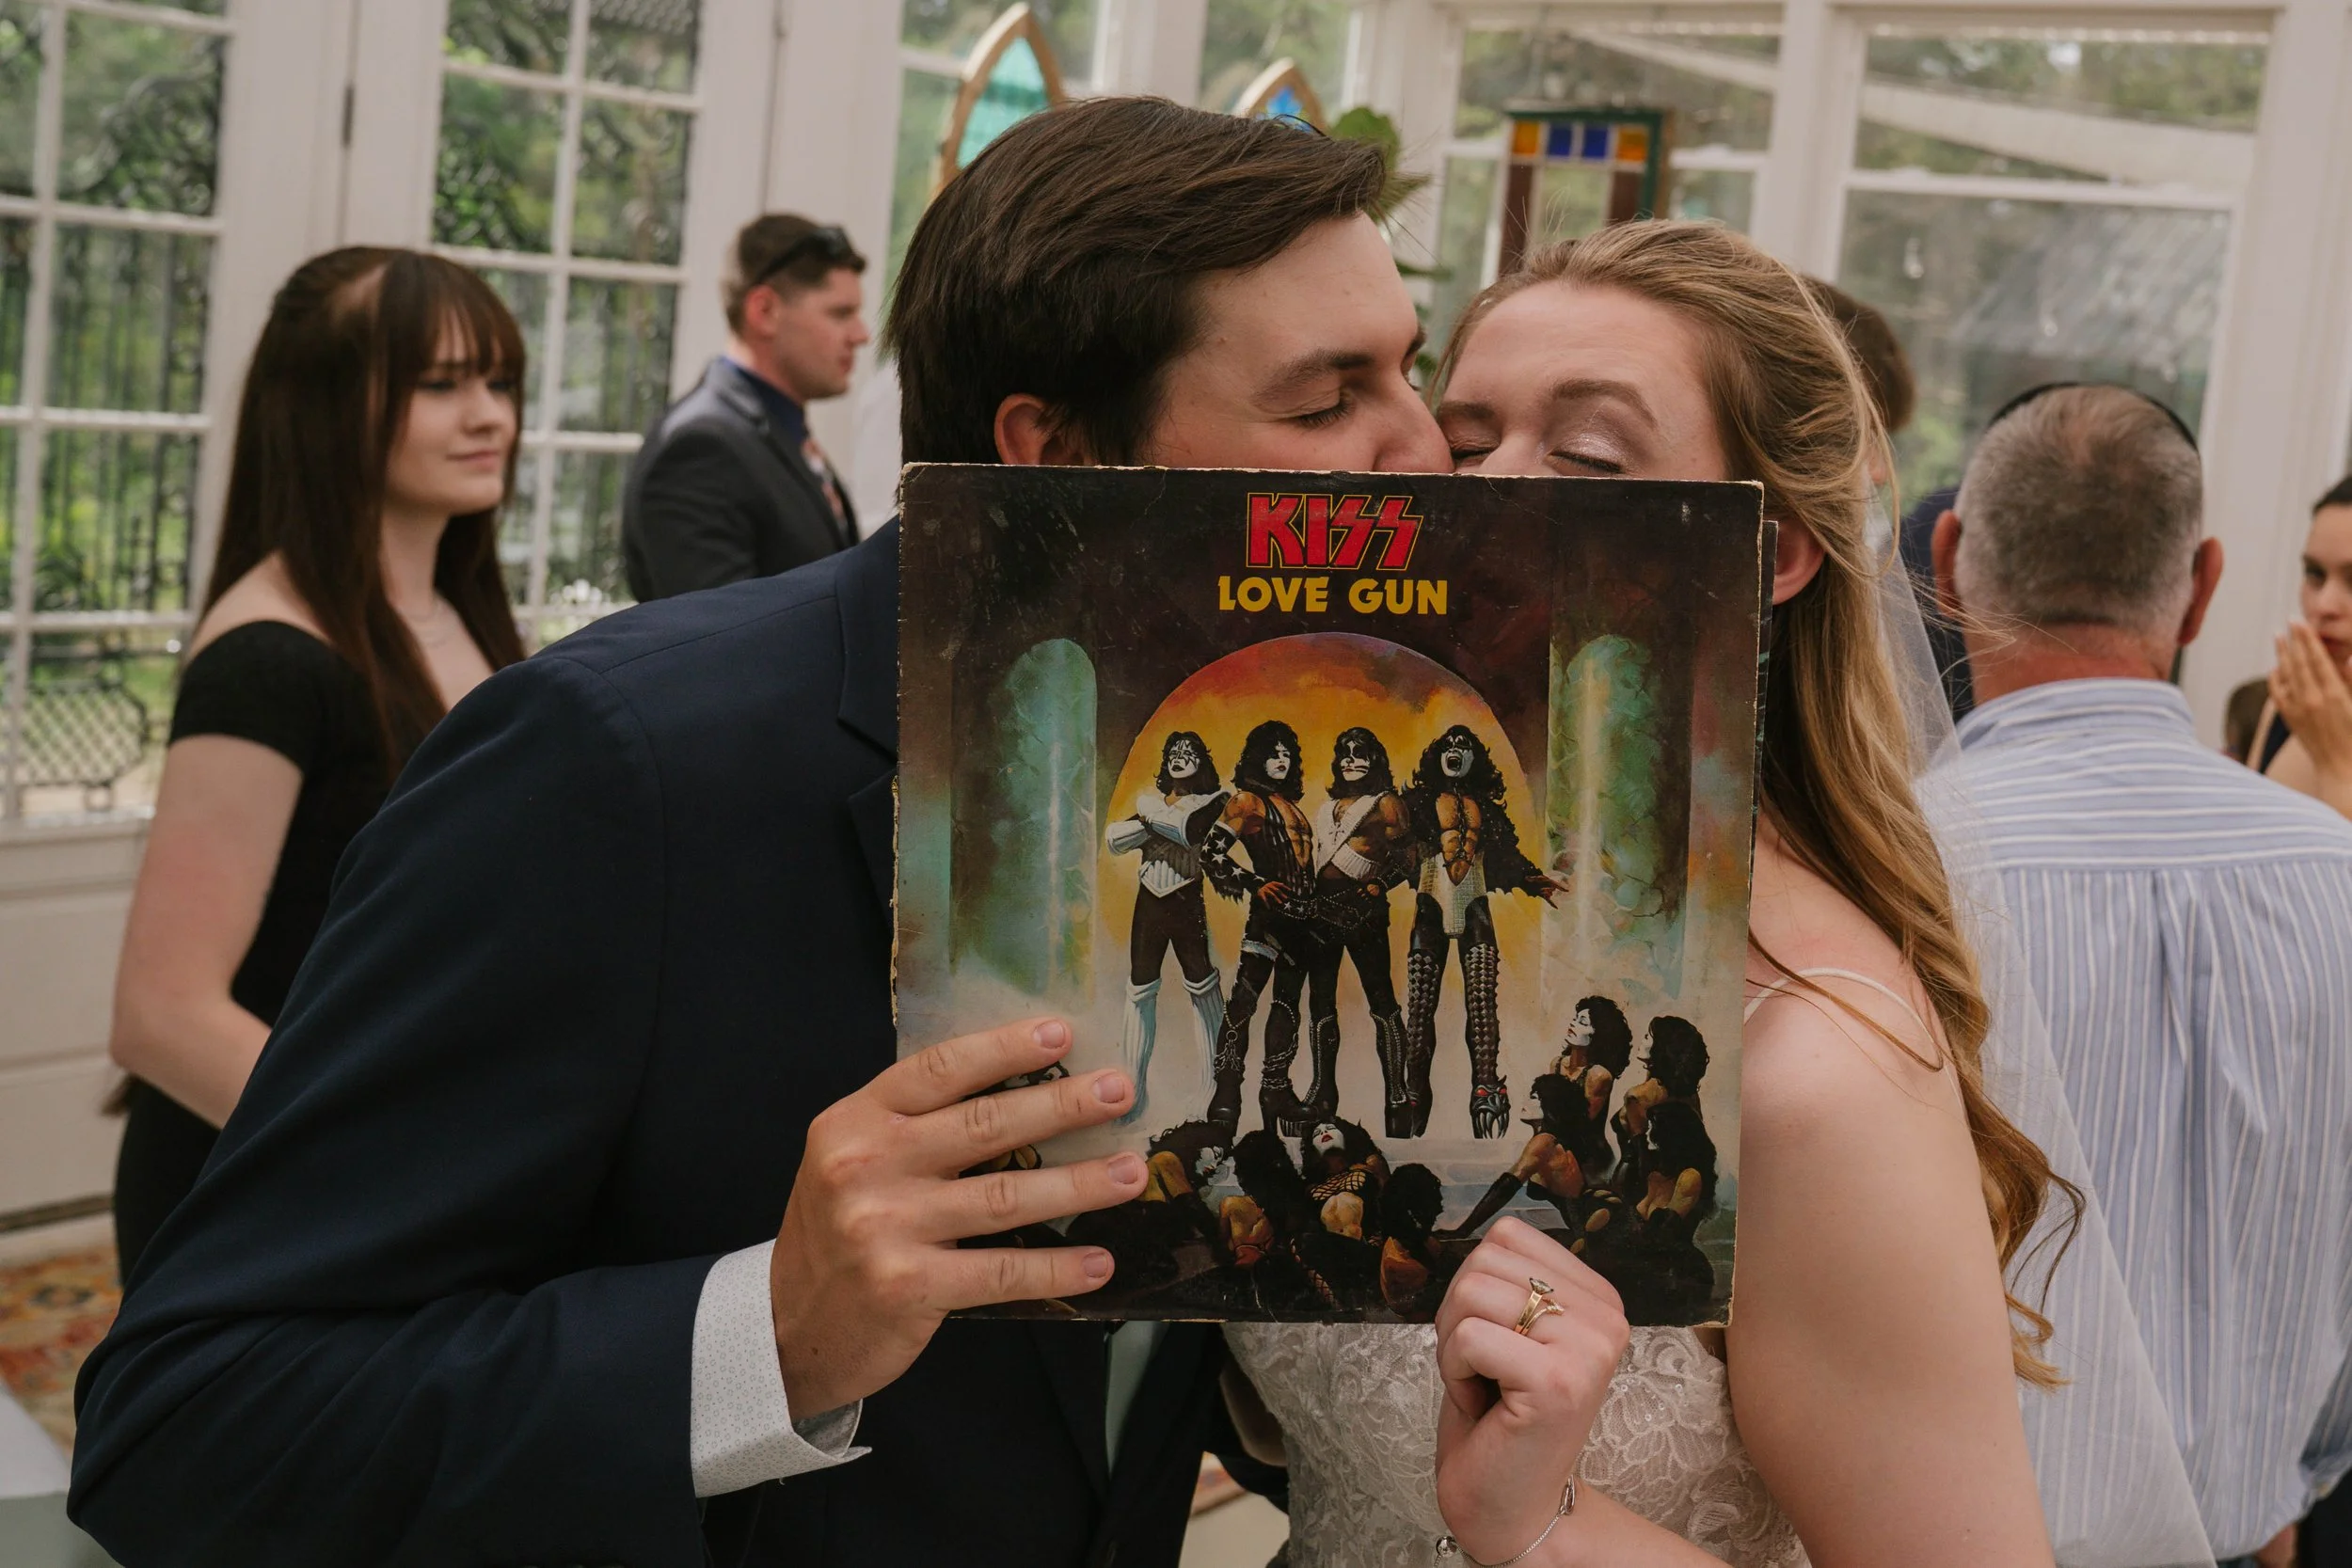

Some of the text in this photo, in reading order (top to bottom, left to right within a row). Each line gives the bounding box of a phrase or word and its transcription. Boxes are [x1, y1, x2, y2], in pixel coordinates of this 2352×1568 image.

[1247, 493, 1423, 570] KISS
[1217, 576, 1447, 614] LOVE GUN
